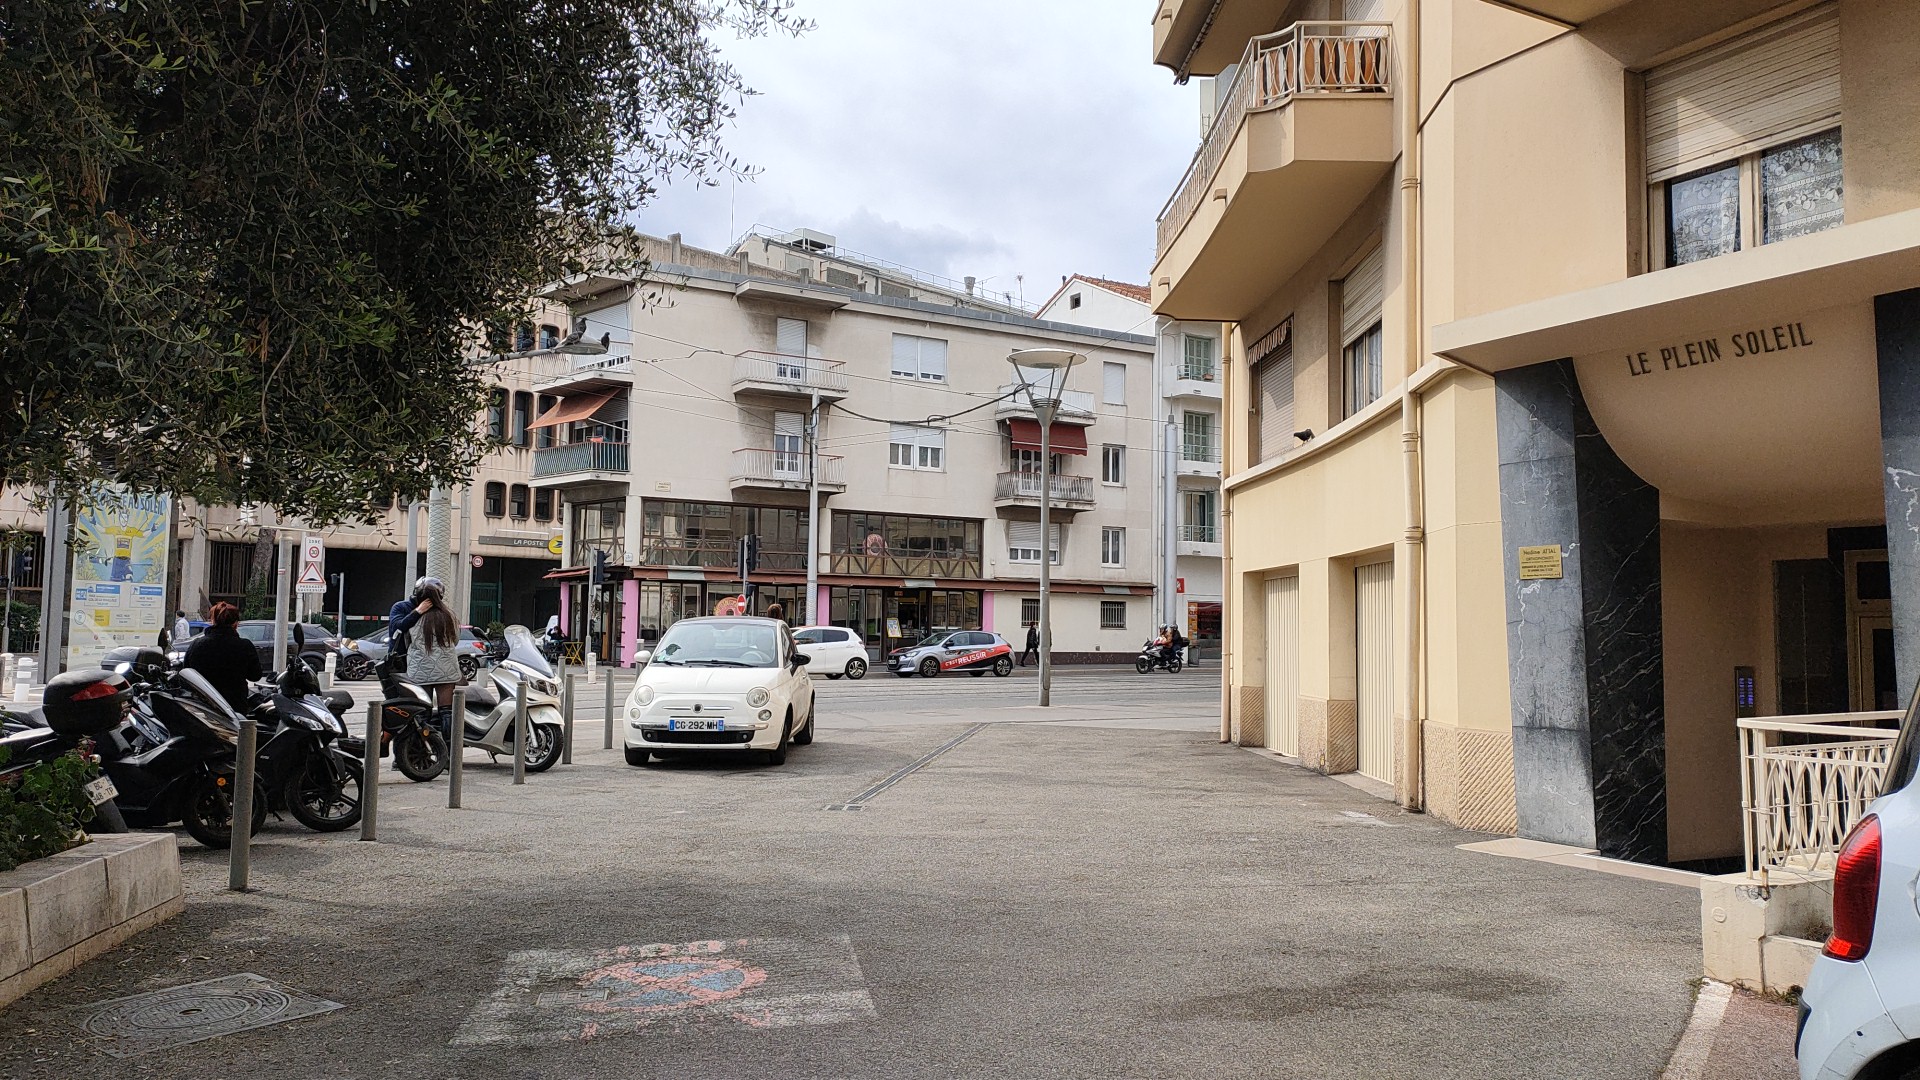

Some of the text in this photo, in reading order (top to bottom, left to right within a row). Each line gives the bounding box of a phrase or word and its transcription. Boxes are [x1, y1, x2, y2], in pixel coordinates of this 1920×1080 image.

[1626, 322, 1814, 376] LE PLEIN SOLEIL
[1529, 403, 1538, 421] 2
[957, 651, 987, 665] REUSSIR
